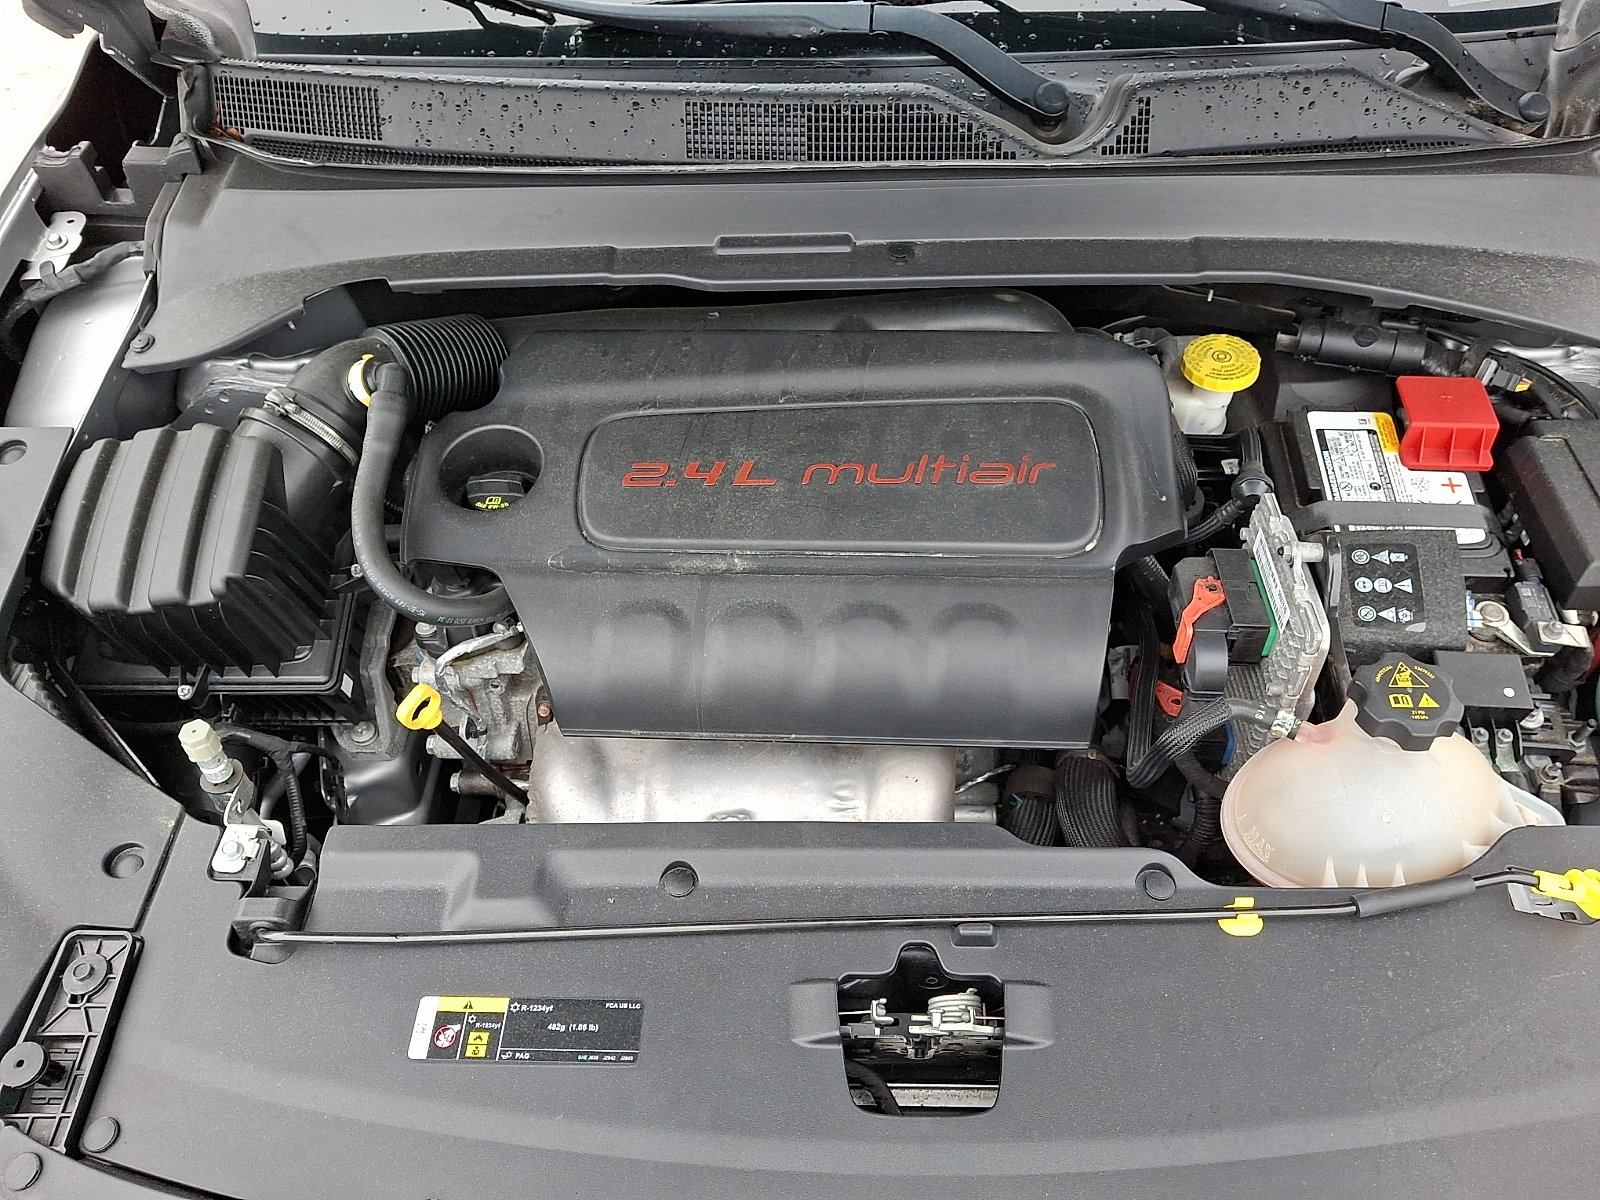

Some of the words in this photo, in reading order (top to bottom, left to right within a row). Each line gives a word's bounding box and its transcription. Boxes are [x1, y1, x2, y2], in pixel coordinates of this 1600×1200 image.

[801, 454, 1056, 485] multiair
[520, 1004, 554, 1014] R-1234yf
[475, 1022, 501, 1030] R-1234yf
[515, 1052, 530, 1060] PAG
